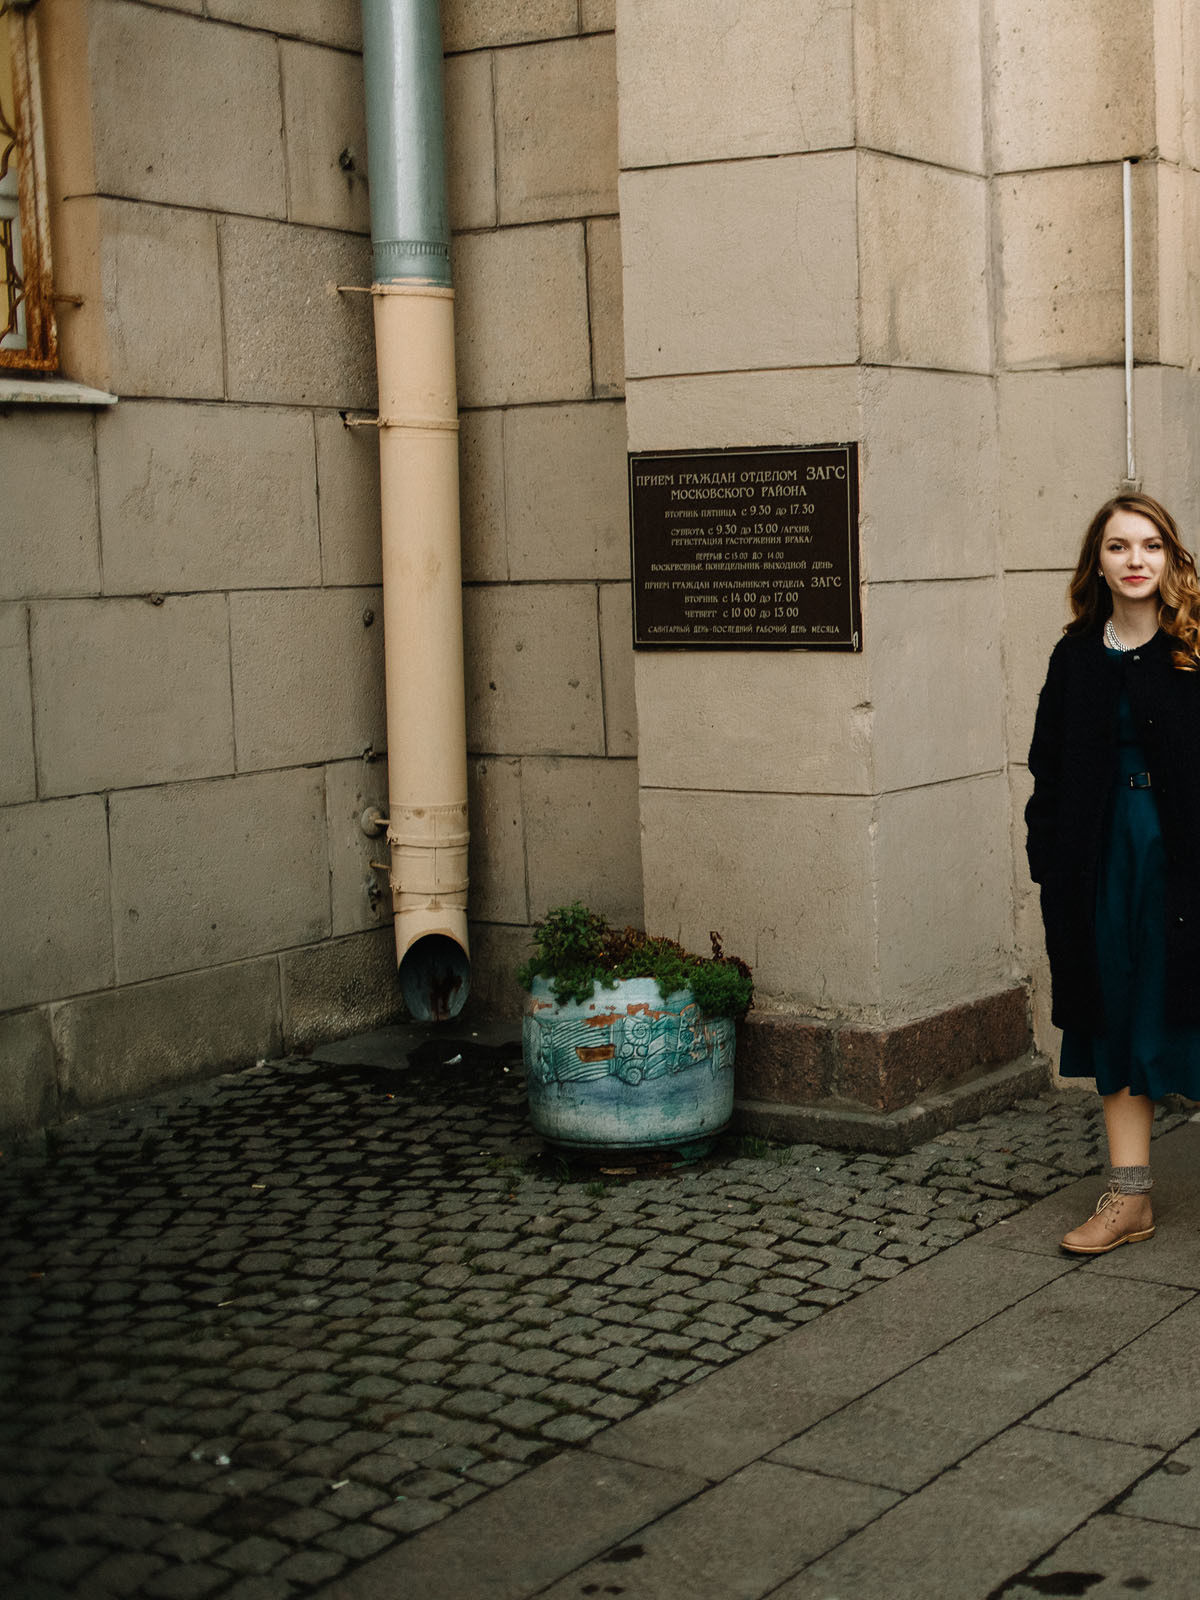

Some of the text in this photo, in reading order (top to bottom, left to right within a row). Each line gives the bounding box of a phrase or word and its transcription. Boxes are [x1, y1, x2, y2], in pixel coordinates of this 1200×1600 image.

[636, 466, 846, 486] ПРИЕМ ГРАЖДАН ОТДЕЛОМ ЗАГС
[671, 484, 807, 500] МОСКОВСКОГО РАЙОНА
[790, 504, 815, 515] 17.30
[725, 536, 781, 545] РАСТОРЖЕНИЯ
[672, 581, 710, 589] ГРАЖДАН
[772, 580, 805, 589] ОТДЕЛА
[810, 576, 842, 588] ЗАГС
[811, 625, 840, 633] МЕСЯЦА
